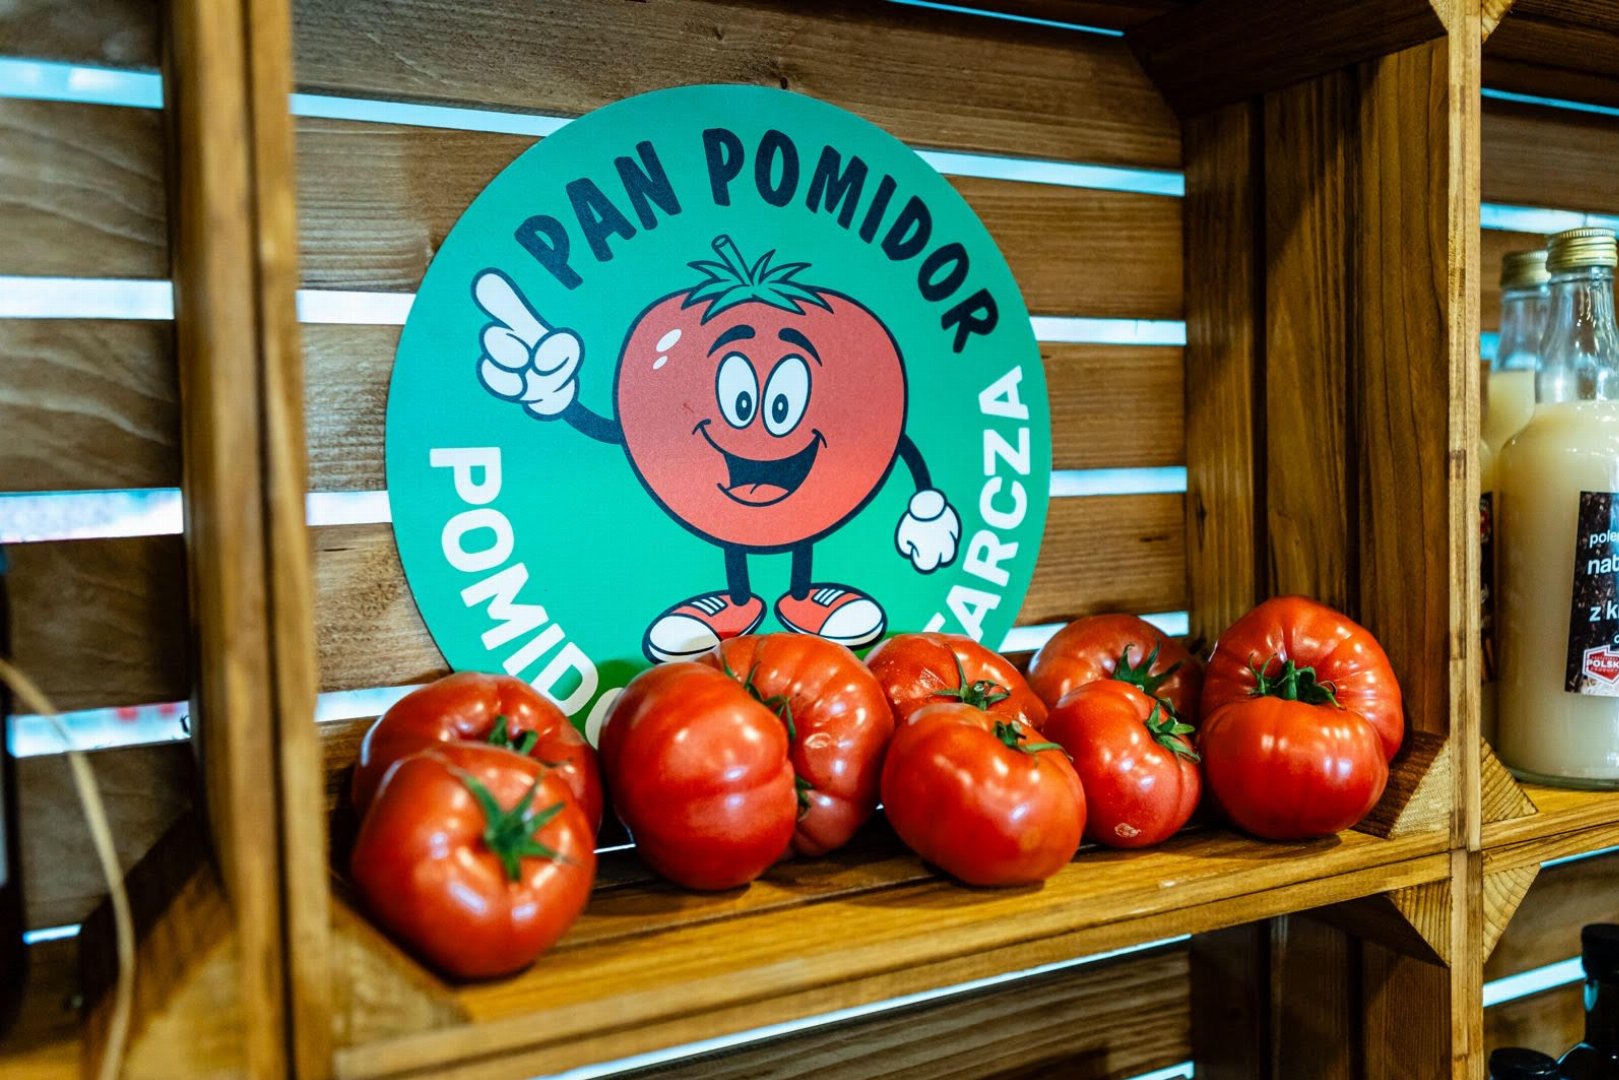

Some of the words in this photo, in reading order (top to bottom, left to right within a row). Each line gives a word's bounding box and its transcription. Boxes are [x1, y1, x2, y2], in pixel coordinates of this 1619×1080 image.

[514, 140, 682, 290] PAN
[702, 127, 998, 353] POMIDOR
[1589, 529, 1619, 549] pole
[1589, 606, 1601, 622] z
